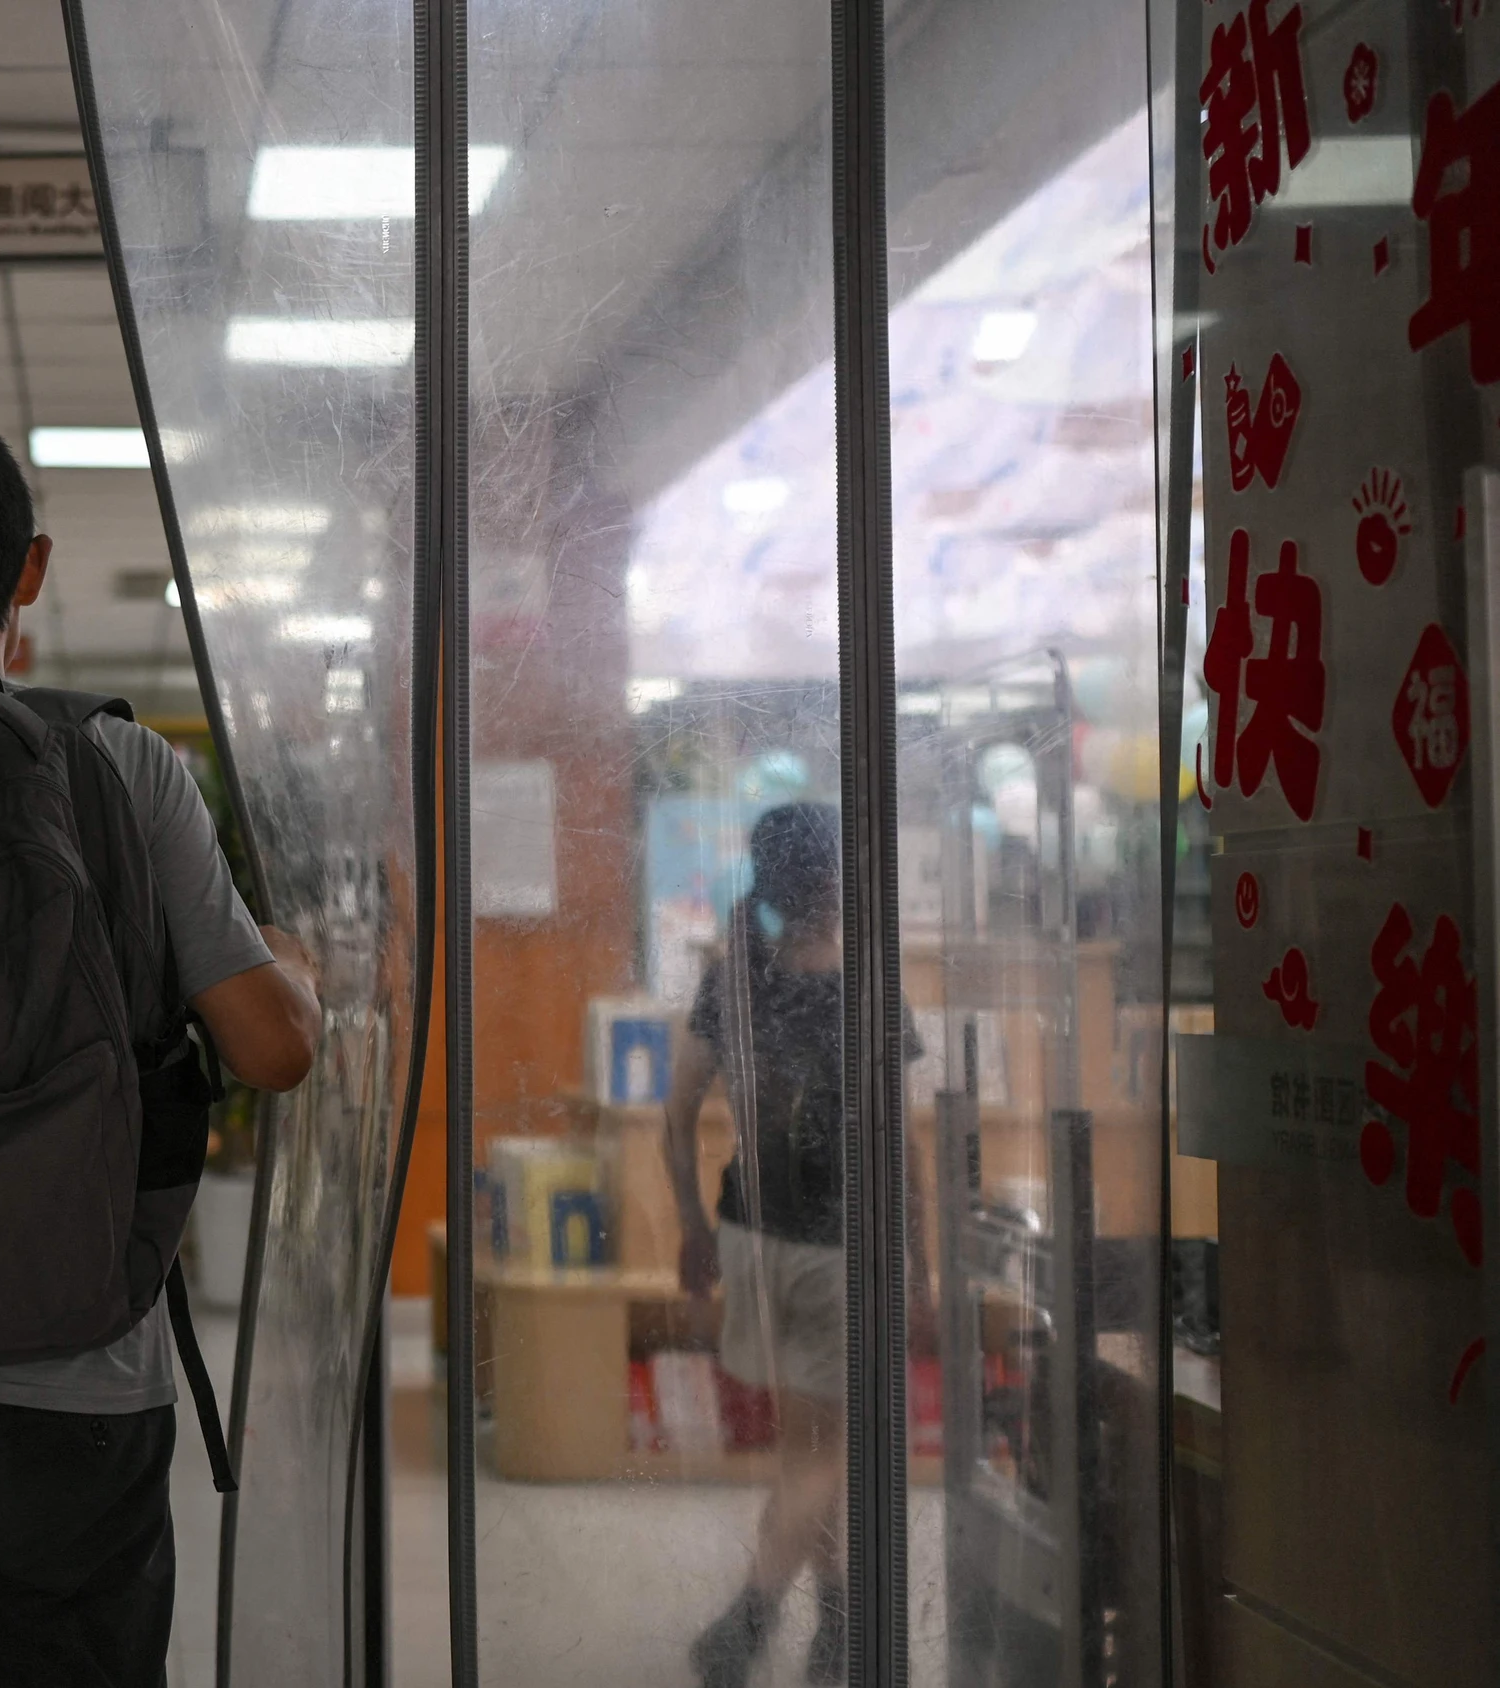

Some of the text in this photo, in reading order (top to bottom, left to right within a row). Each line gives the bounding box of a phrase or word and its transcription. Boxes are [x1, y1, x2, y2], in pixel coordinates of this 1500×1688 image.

[1200, 0, 1309, 251] 新
[1204, 528, 1327, 823] 快
[1407, 664, 1458, 769] 福
